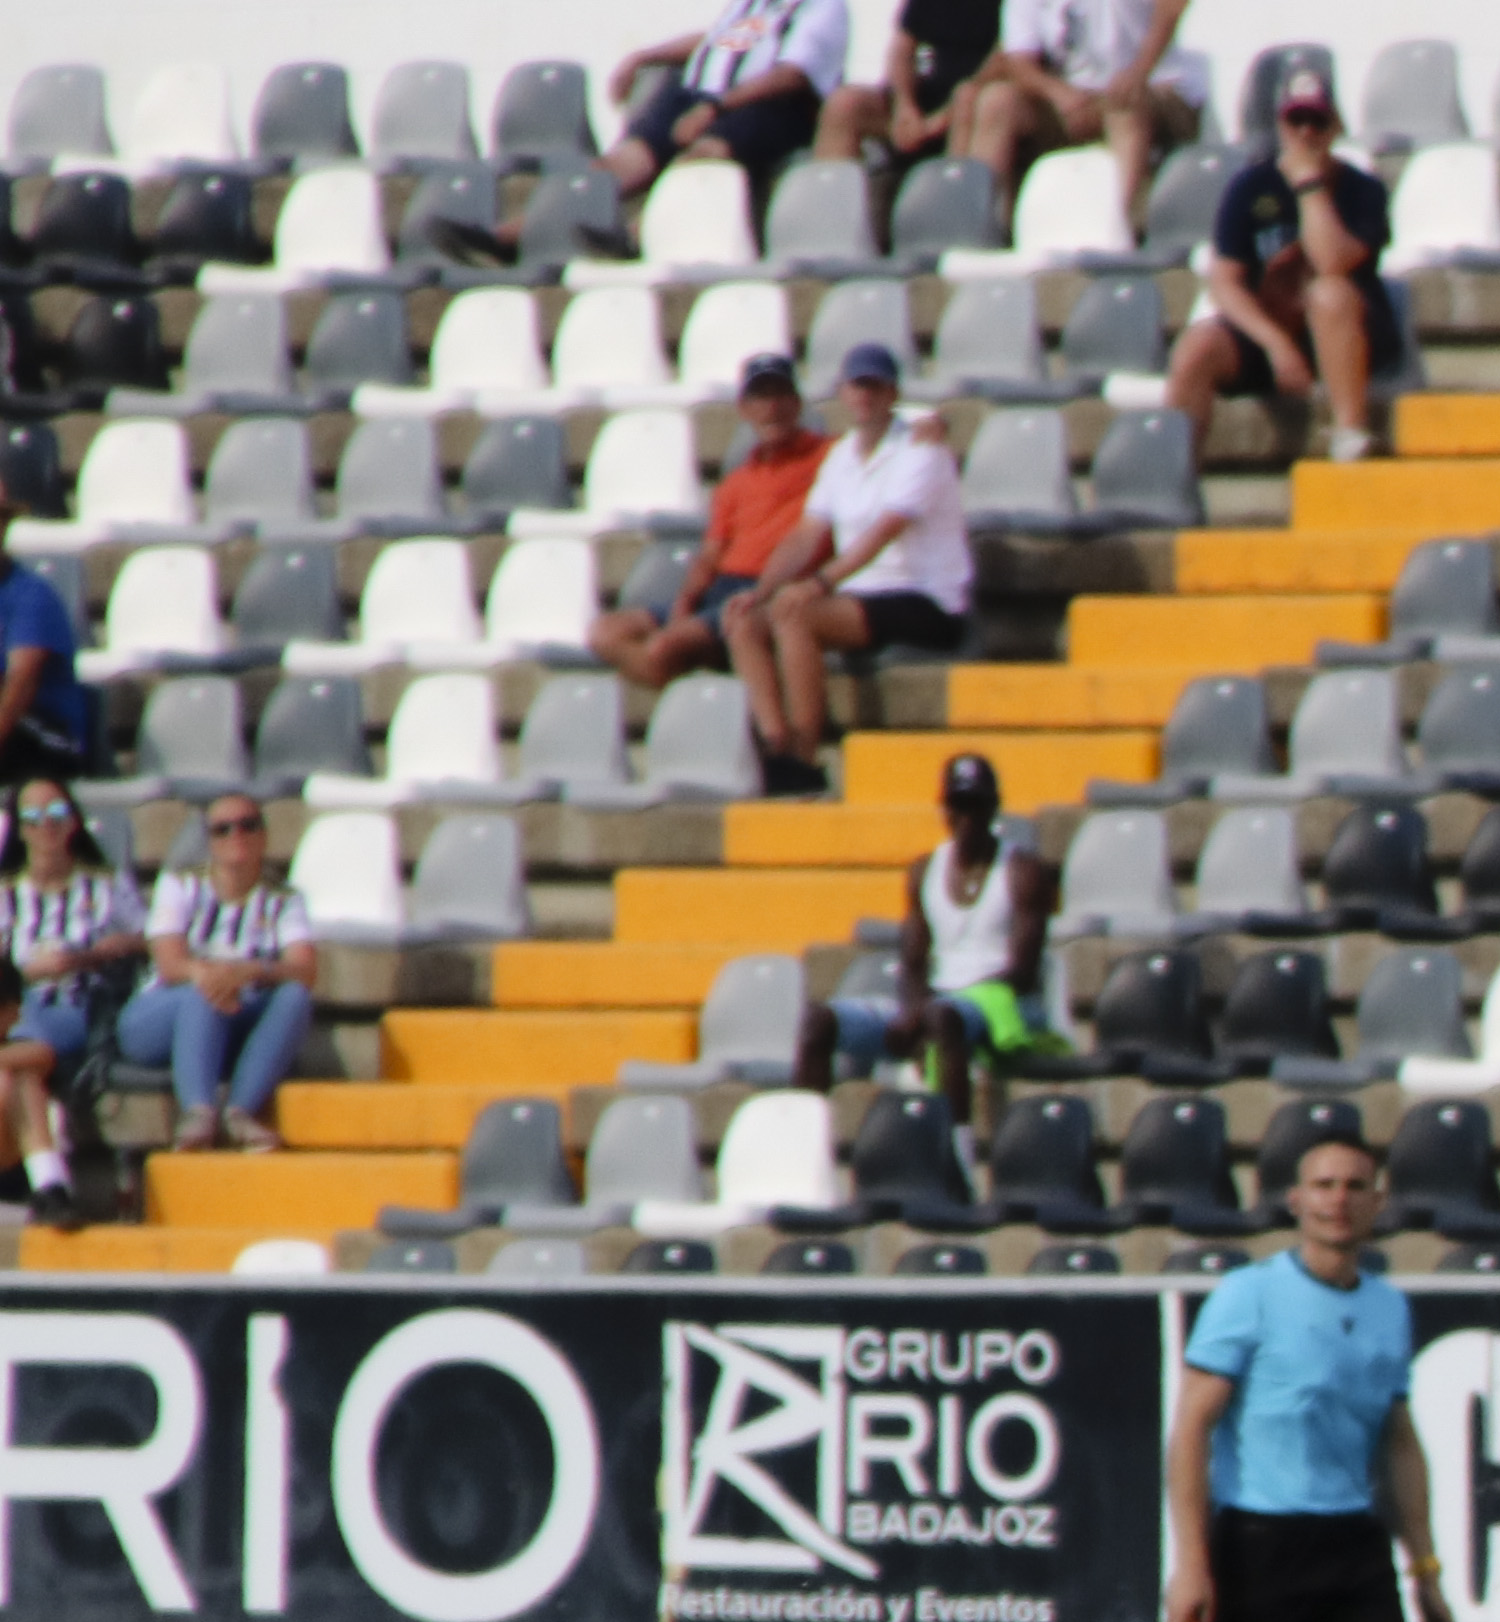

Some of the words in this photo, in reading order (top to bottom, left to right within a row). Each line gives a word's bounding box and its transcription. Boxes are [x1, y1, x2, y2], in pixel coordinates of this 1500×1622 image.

[843, 1328, 1060, 1385] GRUPO
[846, 1391, 1062, 1501] RIO
[846, 1504, 1057, 1548] BADAJOZ
